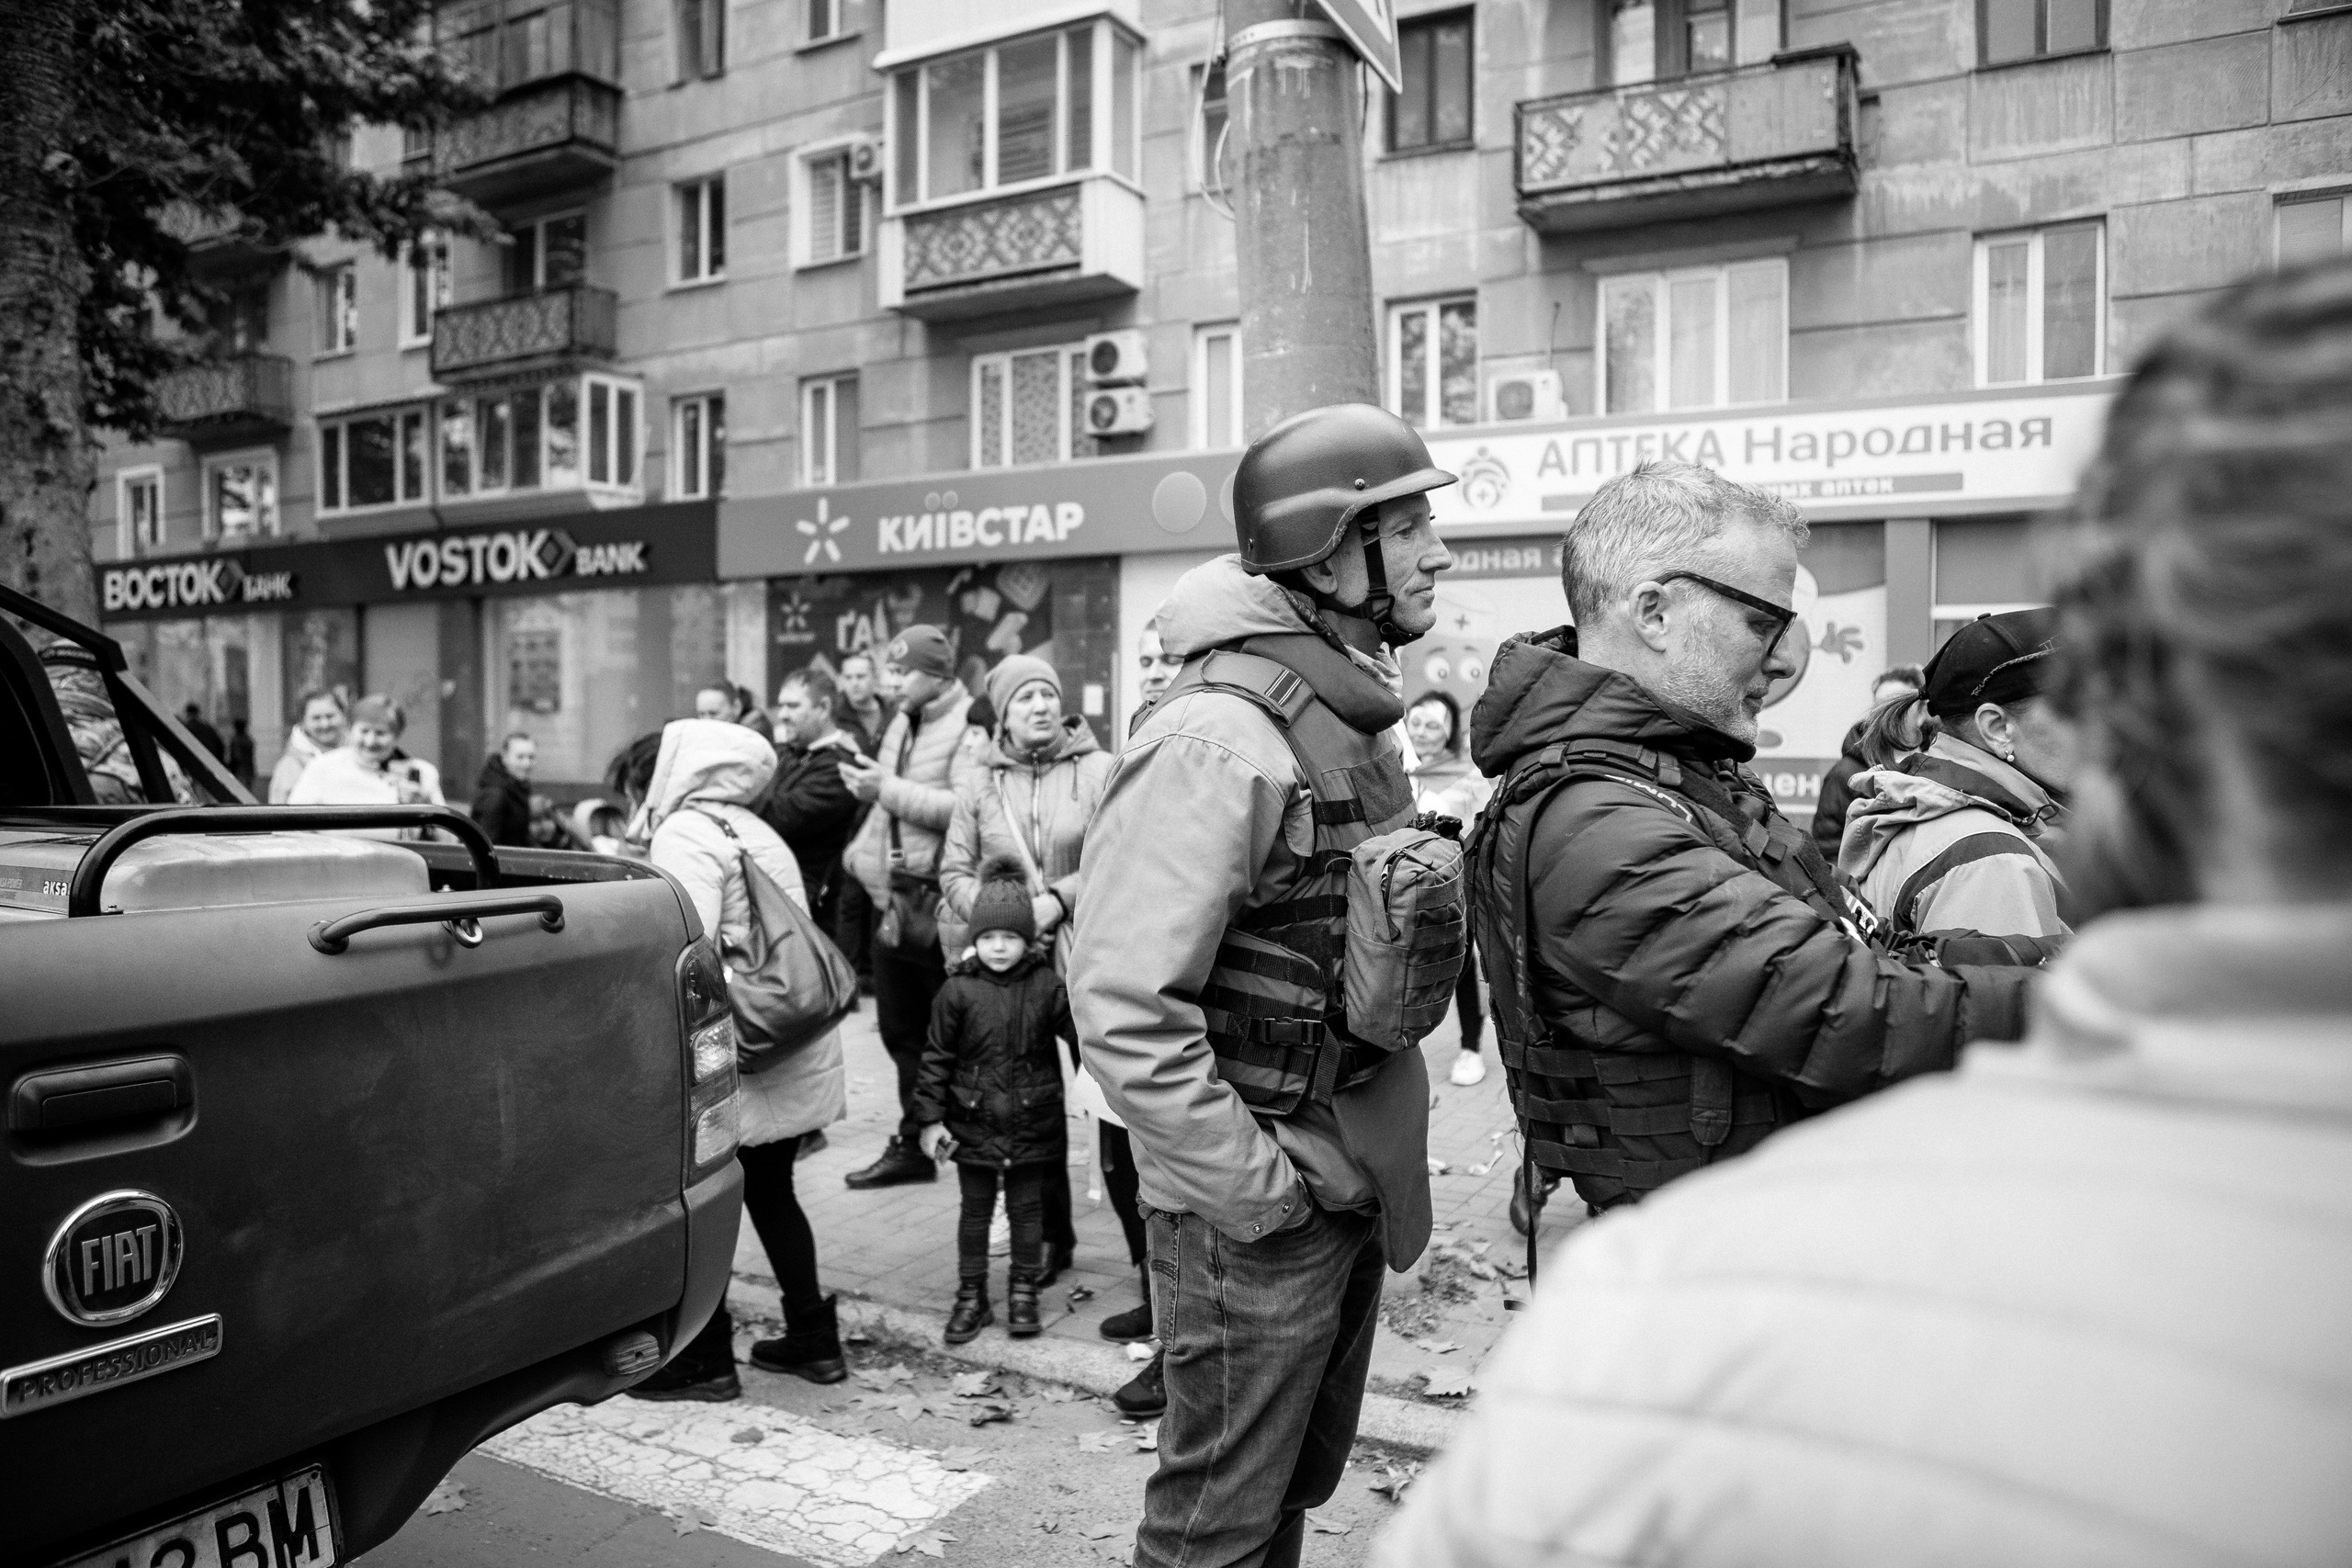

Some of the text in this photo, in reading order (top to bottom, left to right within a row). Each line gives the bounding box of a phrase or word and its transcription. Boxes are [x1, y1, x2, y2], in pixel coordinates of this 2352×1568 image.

[1537, 416, 2053, 478] АПТЕКА Народная
[878, 491, 1084, 553] КИЇВСТАР
[104, 558, 226, 612] ВОСТОК
[385, 528, 646, 590] VOSTOK BANK
[42, 880, 67, 896] aksa
[82, 1224, 157, 1296] FIAT
[18, 1330, 211, 1404] PROFESSIONAL
